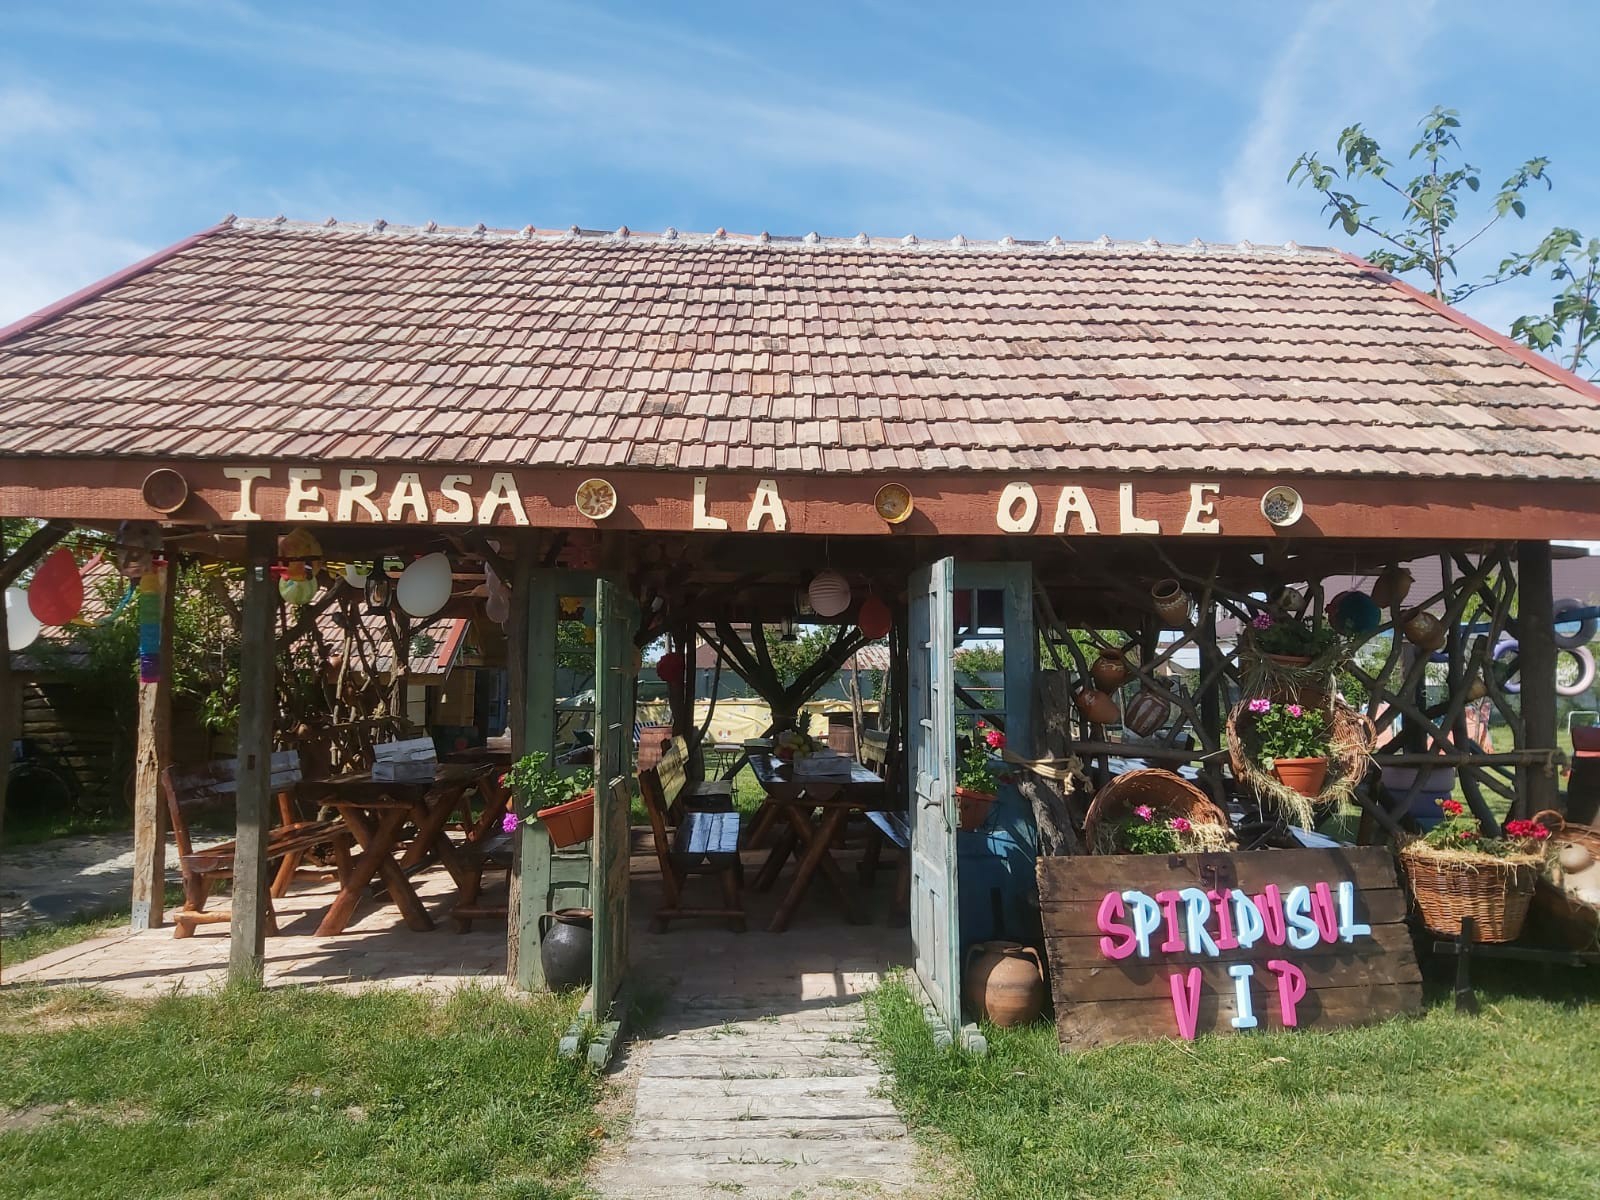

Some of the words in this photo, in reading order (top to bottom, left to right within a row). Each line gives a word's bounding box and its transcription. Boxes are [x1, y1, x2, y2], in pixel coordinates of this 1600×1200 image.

[223, 466, 530, 527] TERASA
[693, 476, 787, 531] LA
[996, 481, 1221, 535] OALE
[1096, 880, 1372, 961] SPIRIDUSUL
[1169, 959, 1308, 1041] VIP
